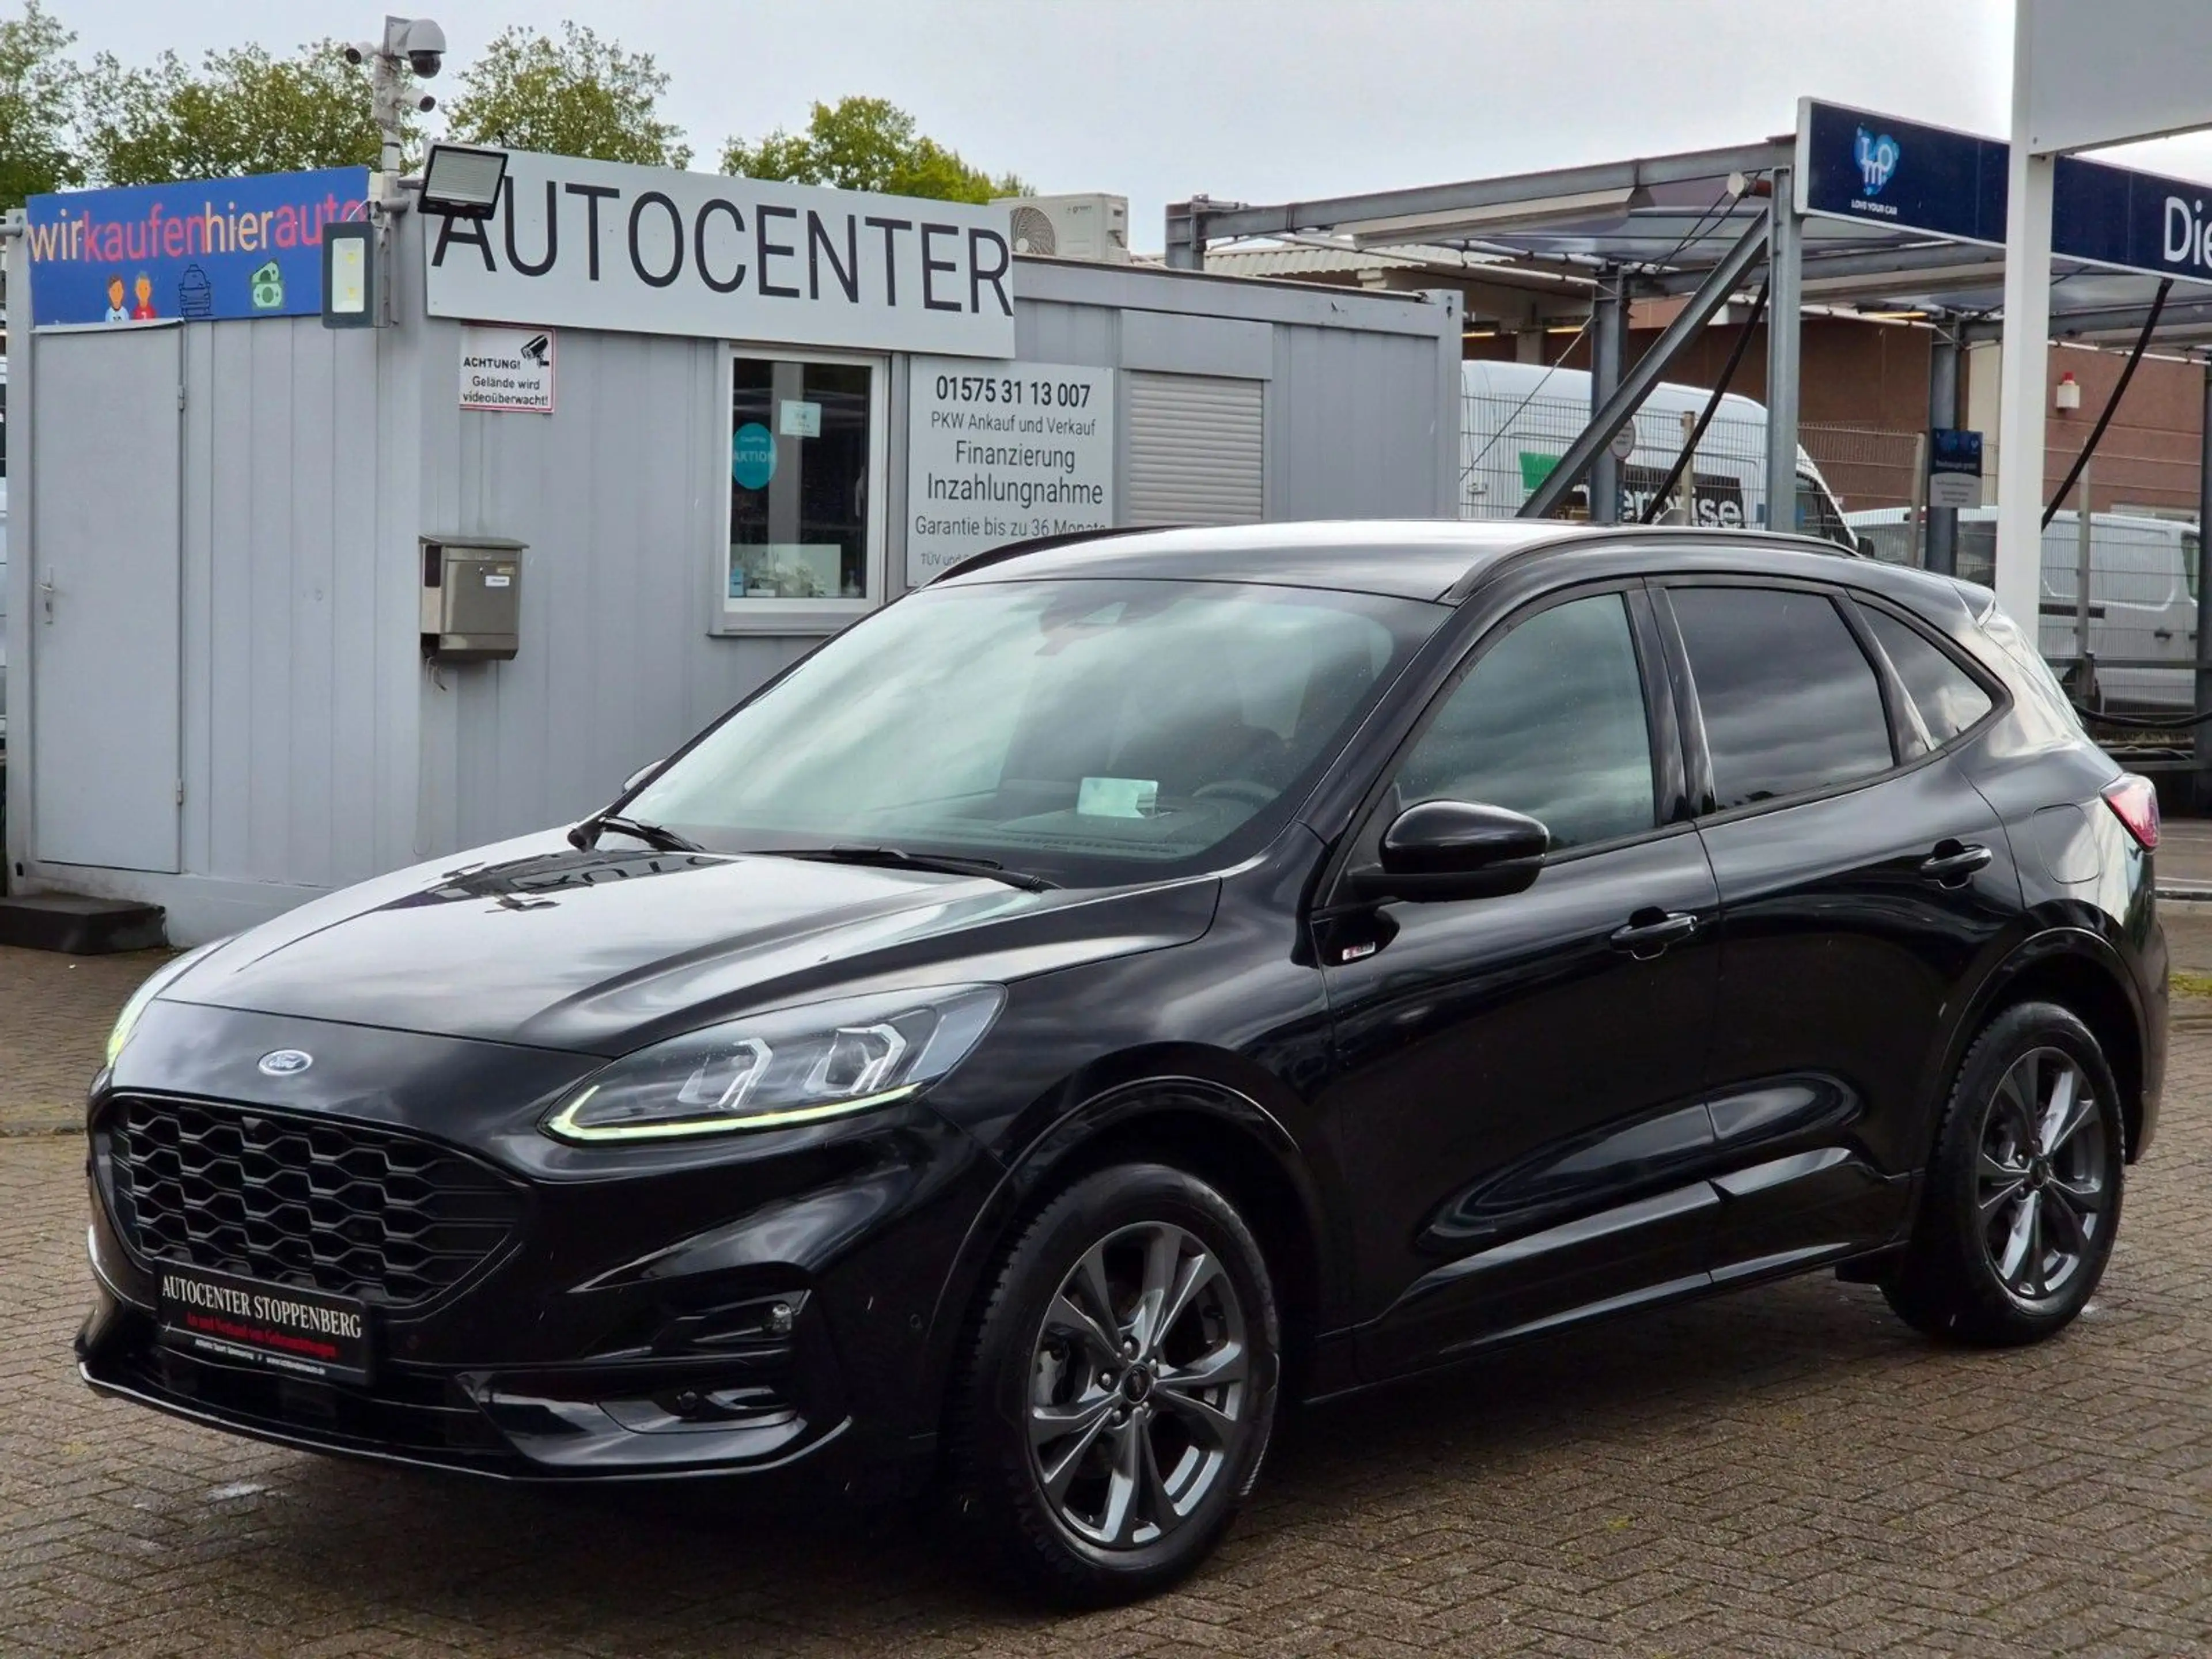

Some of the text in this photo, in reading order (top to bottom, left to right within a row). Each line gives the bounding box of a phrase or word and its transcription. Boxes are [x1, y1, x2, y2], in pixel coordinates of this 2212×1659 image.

[432, 176, 1013, 316] AUTOCENTER
[463, 357, 521, 370] ACHTUNG!
[472, 375, 540, 390] Gelände wird
[936, 375, 1090, 408] 01575 31 13 007
[931, 411, 1096, 436] PKW Ankauf und Verkauf
[956, 440, 1075, 474] Finanzierung
[927, 472, 1103, 509] Inzahlungnahme
[915, 515, 980, 536] Garantie
[984, 517, 1006, 536] bis
[1010, 520, 1028, 537] zu
[1031, 518, 1050, 537] 36
[921, 551, 941, 566] TÜV
[162, 1275, 251, 1318] AUTOCENTER
[254, 1294, 362, 1339] STOPPENBERG
